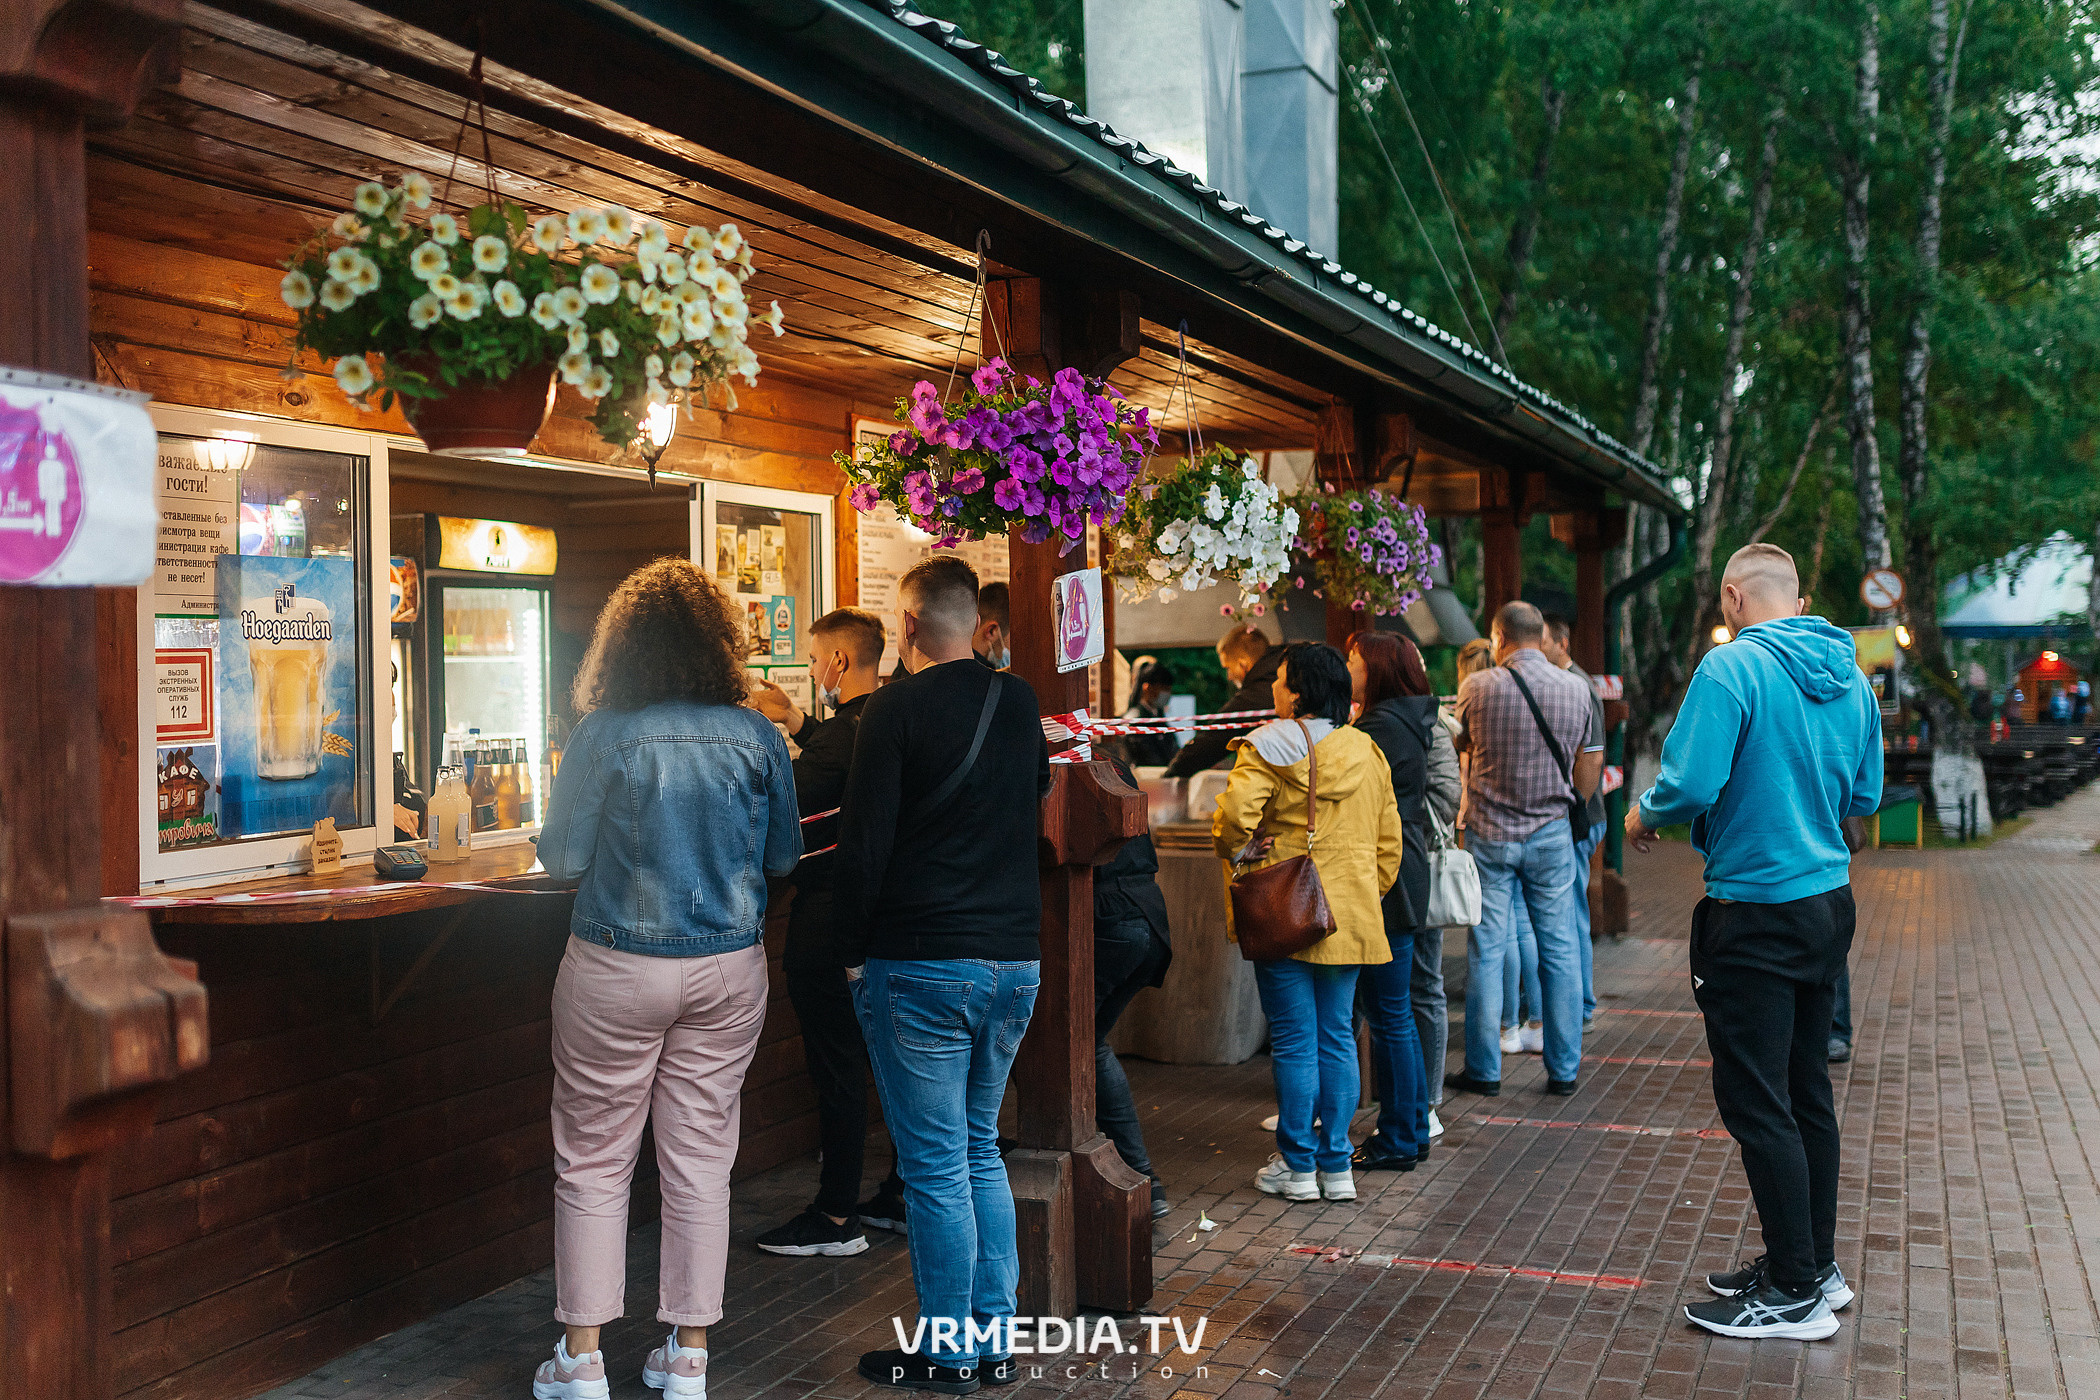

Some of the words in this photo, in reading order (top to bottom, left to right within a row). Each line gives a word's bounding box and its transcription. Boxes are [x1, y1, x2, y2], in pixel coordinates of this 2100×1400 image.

[166, 474, 208, 493] гости!
[161, 511, 212, 523] ставленные
[214, 512, 228, 524] без
[199, 529, 221, 540] вещи
[157, 542, 207, 554] инистрация
[209, 544, 230, 555] кафе
[167, 573, 178, 582] не
[181, 571, 206, 583] несет!
[240, 609, 333, 645] Hoegaarden
[159, 677, 198, 685] ЭКСТРЕННЫХ
[156, 686, 200, 694] ОПЕРАТИВНЫХ
[168, 694, 189, 702] СЛУЖБ
[170, 705, 188, 719] 112
[158, 764, 199, 783] КАФЕ
